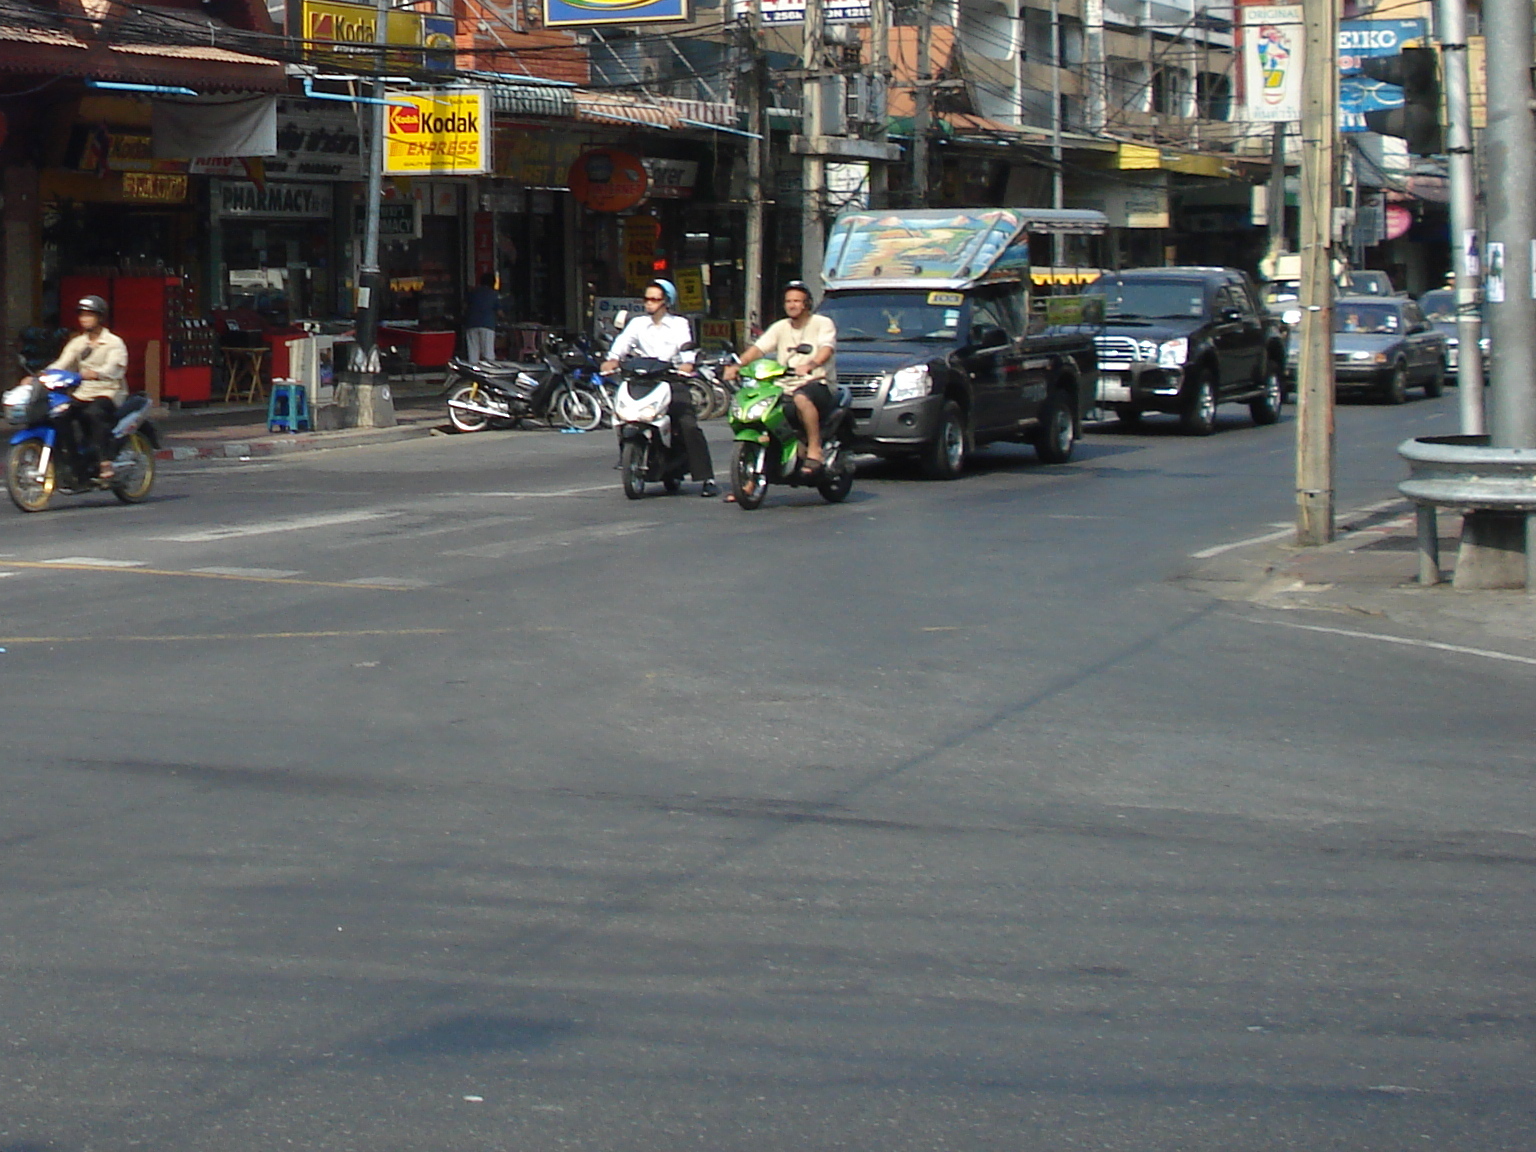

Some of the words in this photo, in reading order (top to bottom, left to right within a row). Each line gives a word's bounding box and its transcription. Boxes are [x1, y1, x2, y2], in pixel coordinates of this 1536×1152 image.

[1248, 8, 1300, 20] ORIGINAL
[1338, 29, 1397, 49] EIKO
[394, 114, 419, 124] Kodak
[421, 112, 478, 134] Kodak
[406, 140, 479, 156] EXPRESS
[222, 186, 313, 213] PHARMACY
[702, 323, 730, 337] TAXI
